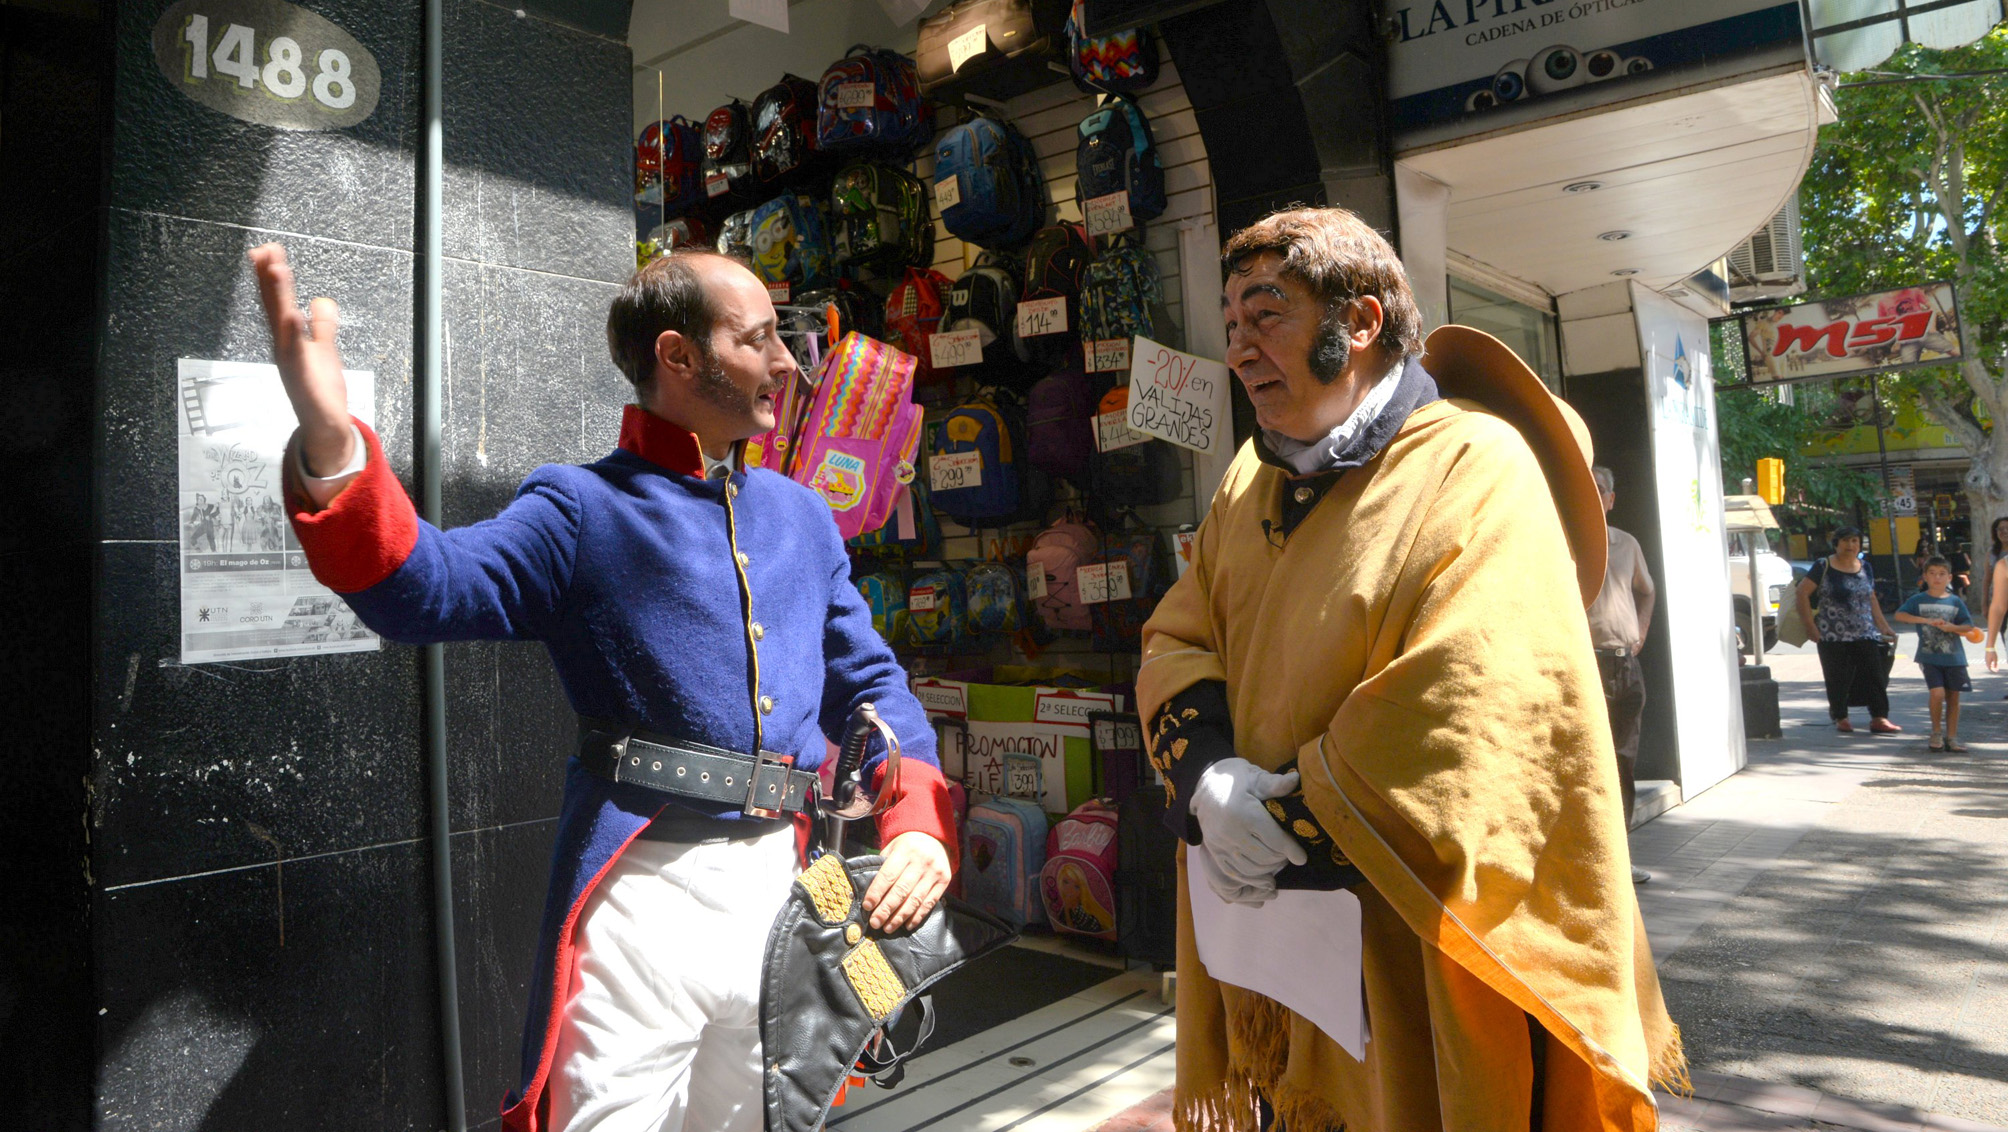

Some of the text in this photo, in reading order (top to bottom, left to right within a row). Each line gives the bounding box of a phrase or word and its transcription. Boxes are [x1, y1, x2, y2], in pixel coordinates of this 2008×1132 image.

[1397, 0, 1458, 44] LA
[1465, 0, 1645, 46] CADENA DE ÓPTIC
[181, 13, 357, 110] 1488
[1147, 348, 1214, 399] -20% en
[1135, 378, 1213, 429] VALIJAS
[1131, 402, 1210, 450] GRANDES
[828, 453, 861, 473] LUNA
[219, 559, 228, 567] El
[228, 559, 249, 568] mago
[249, 558, 259, 566] de
[259, 557, 270, 566] Oz
[239, 614, 273, 623] CORO UTN
[925, 692, 962, 707] SELECCION
[1039, 702, 1052, 714] 2ª
[983, 757, 1003, 775] A
[1061, 821, 1110, 850] Barbie
